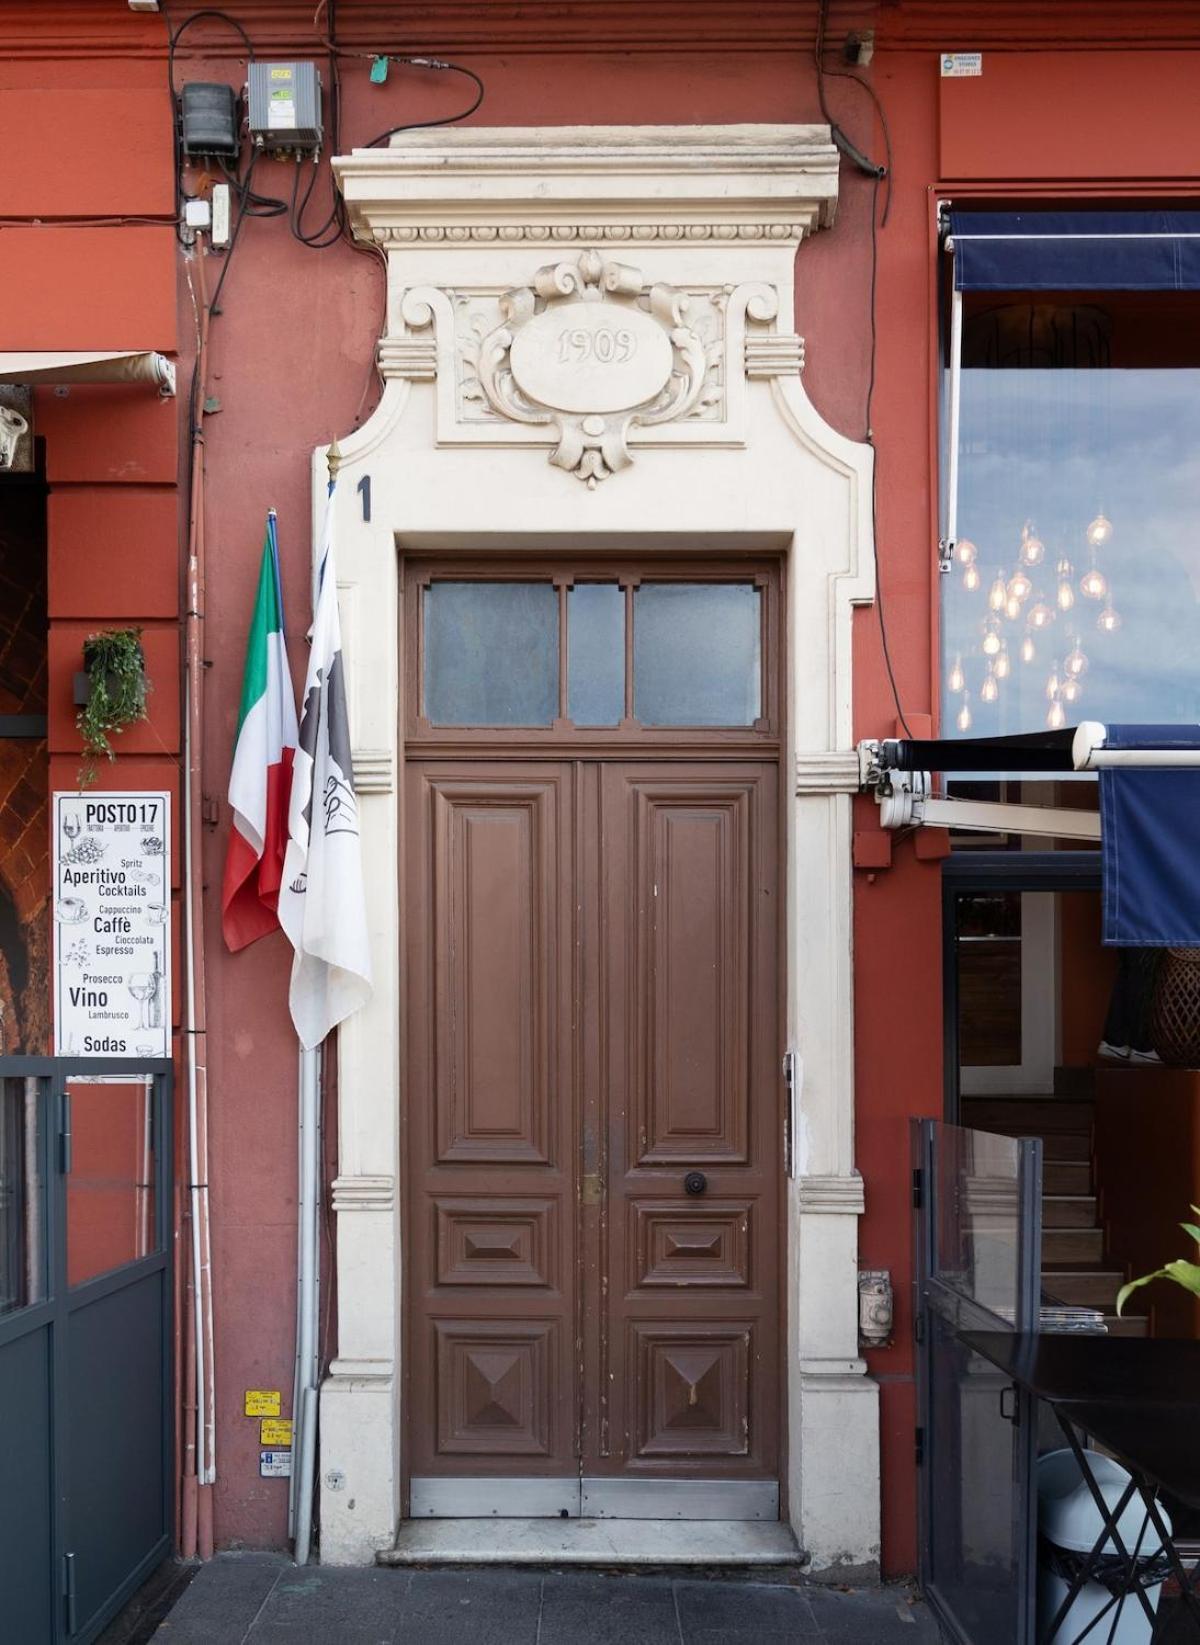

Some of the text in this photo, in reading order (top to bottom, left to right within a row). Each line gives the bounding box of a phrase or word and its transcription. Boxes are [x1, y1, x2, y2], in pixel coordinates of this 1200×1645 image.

[557, 328, 636, 363] 1909
[357, 475, 371, 522] 1
[121, 859, 142, 868] Spritz
[64, 868, 126, 887] Aperitivo
[98, 884, 147, 897] Cocktails
[99, 905, 142, 916] Cappuccino
[94, 916, 131, 933] Caffè
[115, 935, 154, 944] Cioccolata
[96, 945, 134, 956] Espresso
[82, 973, 123, 984] Prosecco
[69, 987, 108, 1007] Vino
[88, 1010, 129, 1019] Lambrusco
[84, 1036, 126, 1052] Sodas
